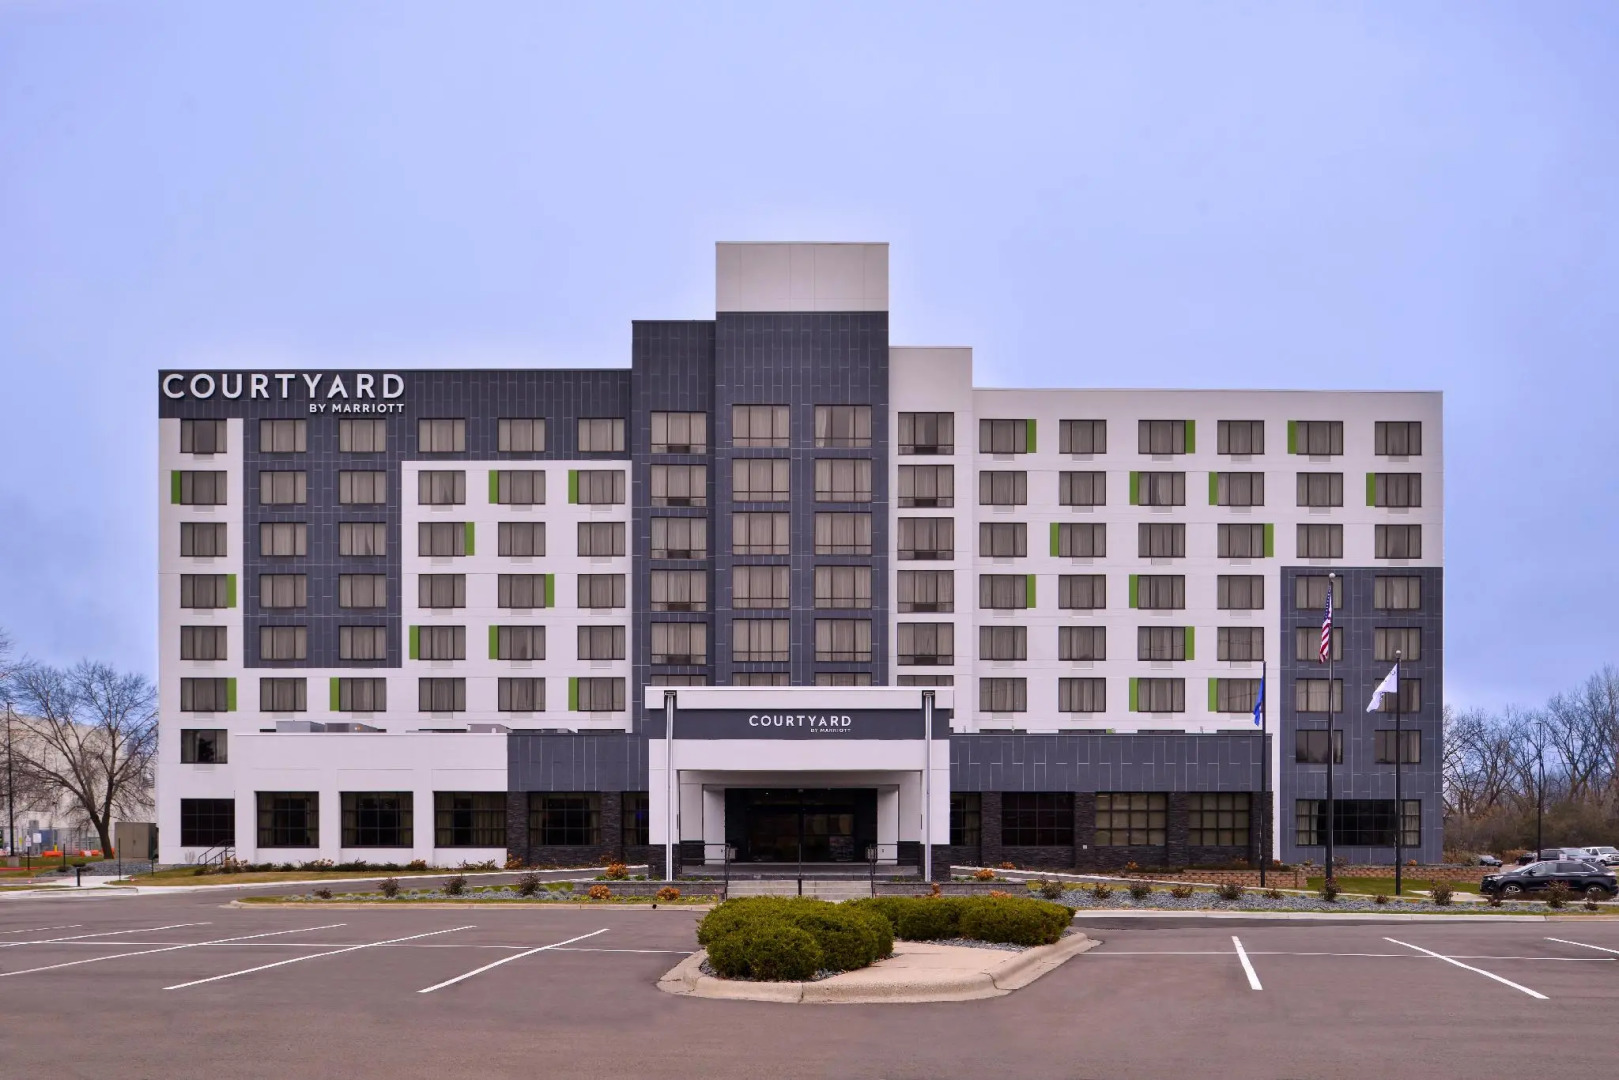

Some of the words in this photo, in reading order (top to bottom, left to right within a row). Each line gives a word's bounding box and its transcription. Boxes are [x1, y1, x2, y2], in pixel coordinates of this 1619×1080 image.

[162, 373, 405, 399] COURTYARD
[309, 403, 326, 413] BY
[332, 403, 405, 413] MARRIOTT
[748, 714, 852, 727] COURTYARD
